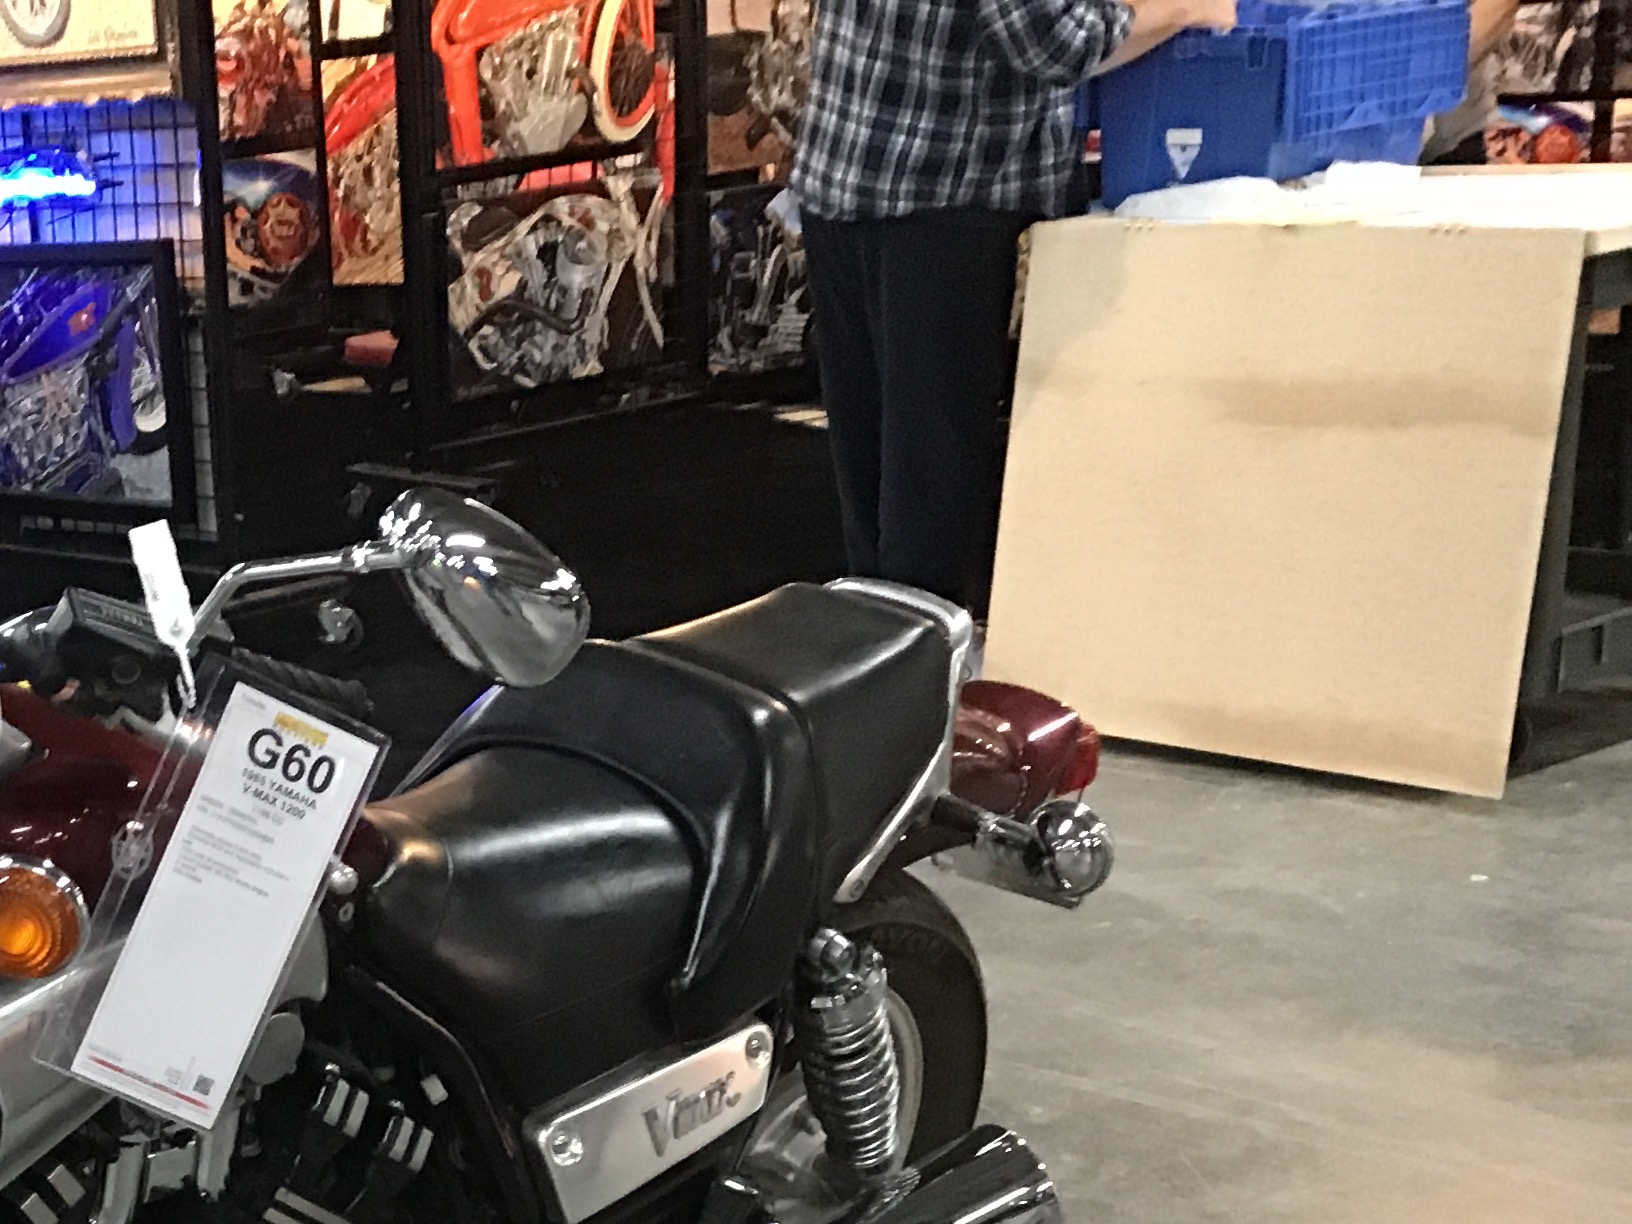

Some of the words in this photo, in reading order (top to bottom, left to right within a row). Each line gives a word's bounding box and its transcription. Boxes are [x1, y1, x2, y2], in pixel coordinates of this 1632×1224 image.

[247, 727, 337, 794] G60
[242, 783, 279, 806] V-MAX
[269, 780, 318, 810] YAMAHA
